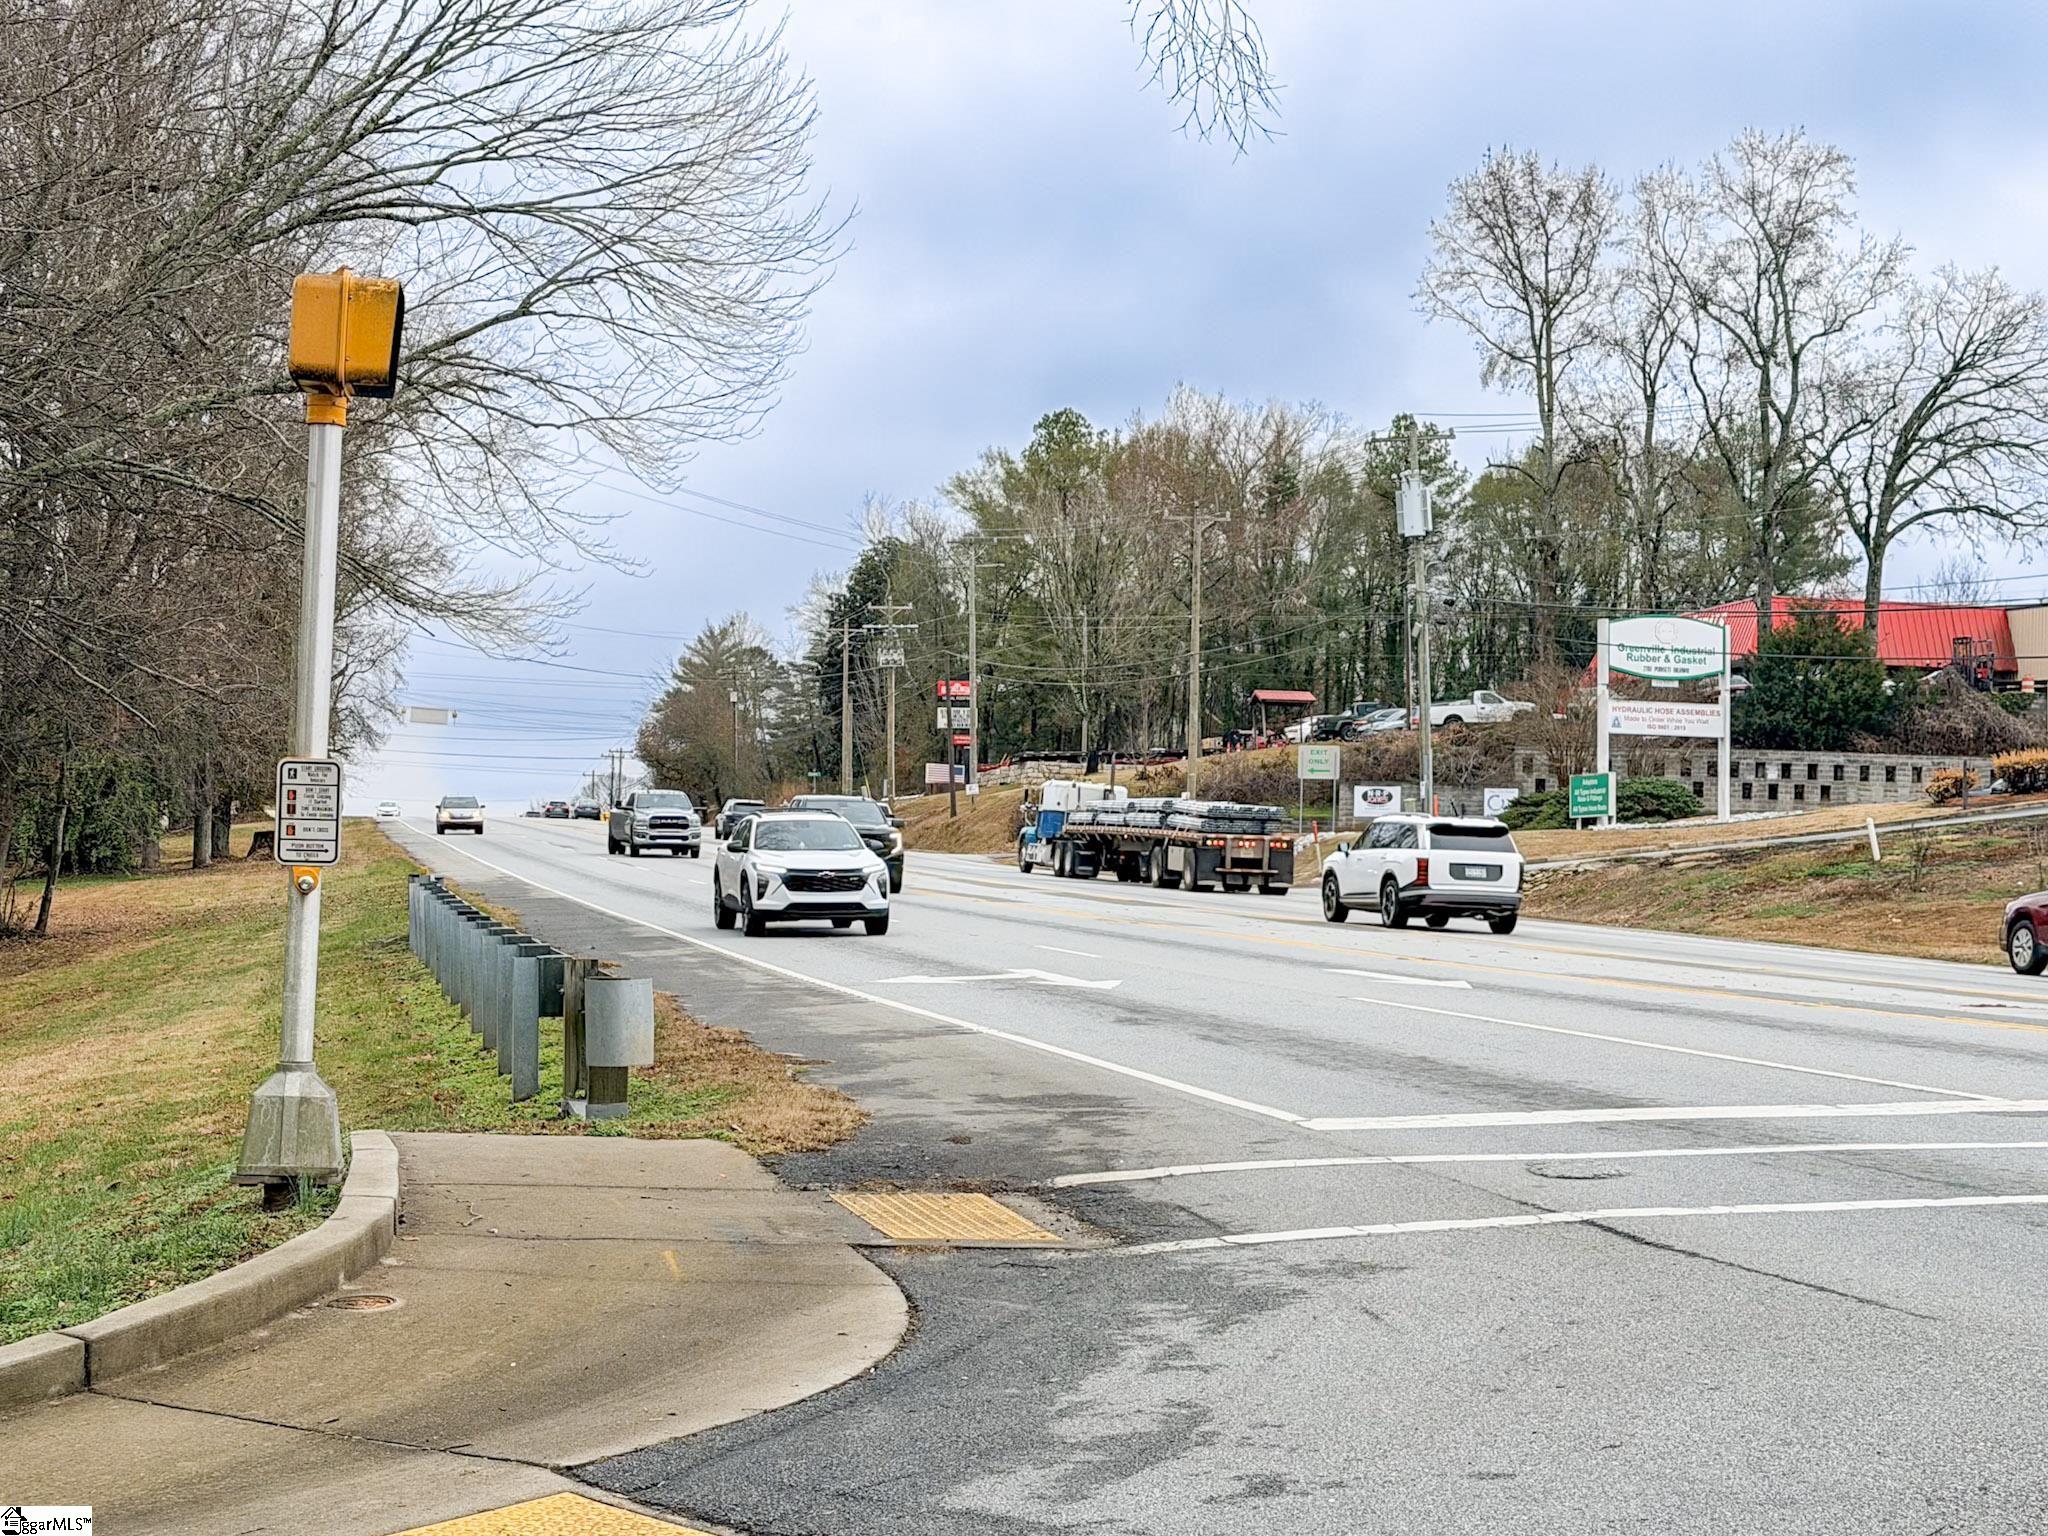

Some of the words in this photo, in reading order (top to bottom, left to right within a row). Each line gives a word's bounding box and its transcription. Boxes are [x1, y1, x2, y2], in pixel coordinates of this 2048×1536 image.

[1617, 643, 1665, 654] Greenville
[1671, 645, 1716, 656] Industrial
[1626, 653, 1660, 663] Rubber
[1663, 655, 1671, 663] &
[1673, 654, 1707, 666] Gasket
[1611, 706, 1653, 714] HYDRAULIC
[1676, 708, 1721, 717] ASSEMBLIES
